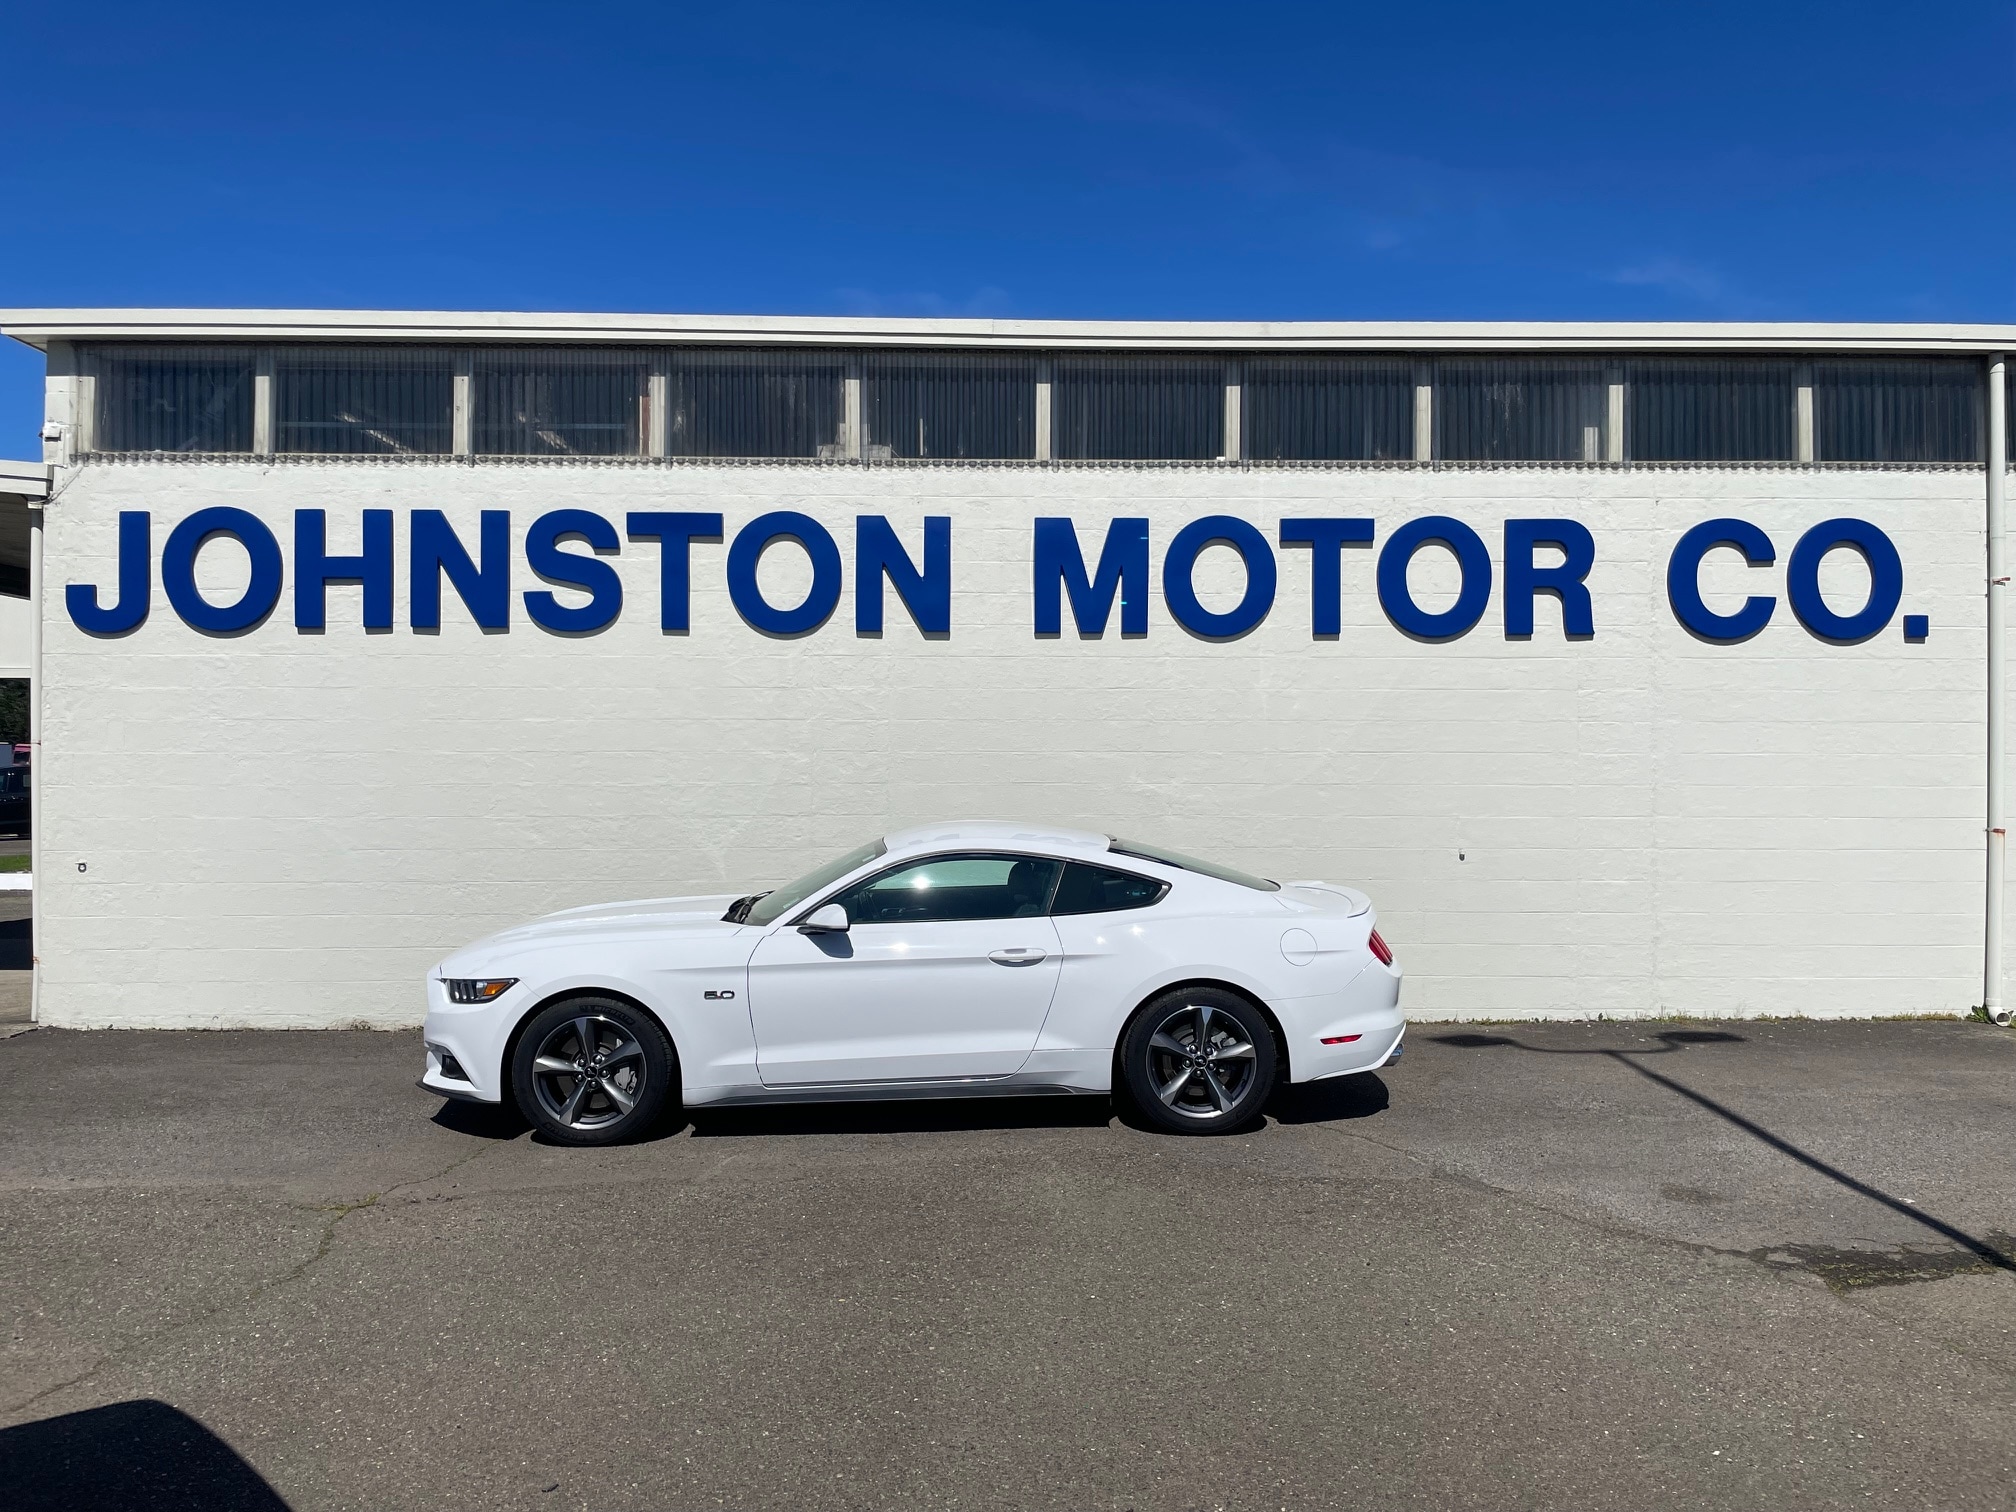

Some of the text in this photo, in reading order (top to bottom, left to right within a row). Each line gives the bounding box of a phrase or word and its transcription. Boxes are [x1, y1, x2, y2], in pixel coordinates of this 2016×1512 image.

[66, 507, 1929, 643] JOHNSTON MOTOR CO.
[704, 990, 735, 1000] 5.0
